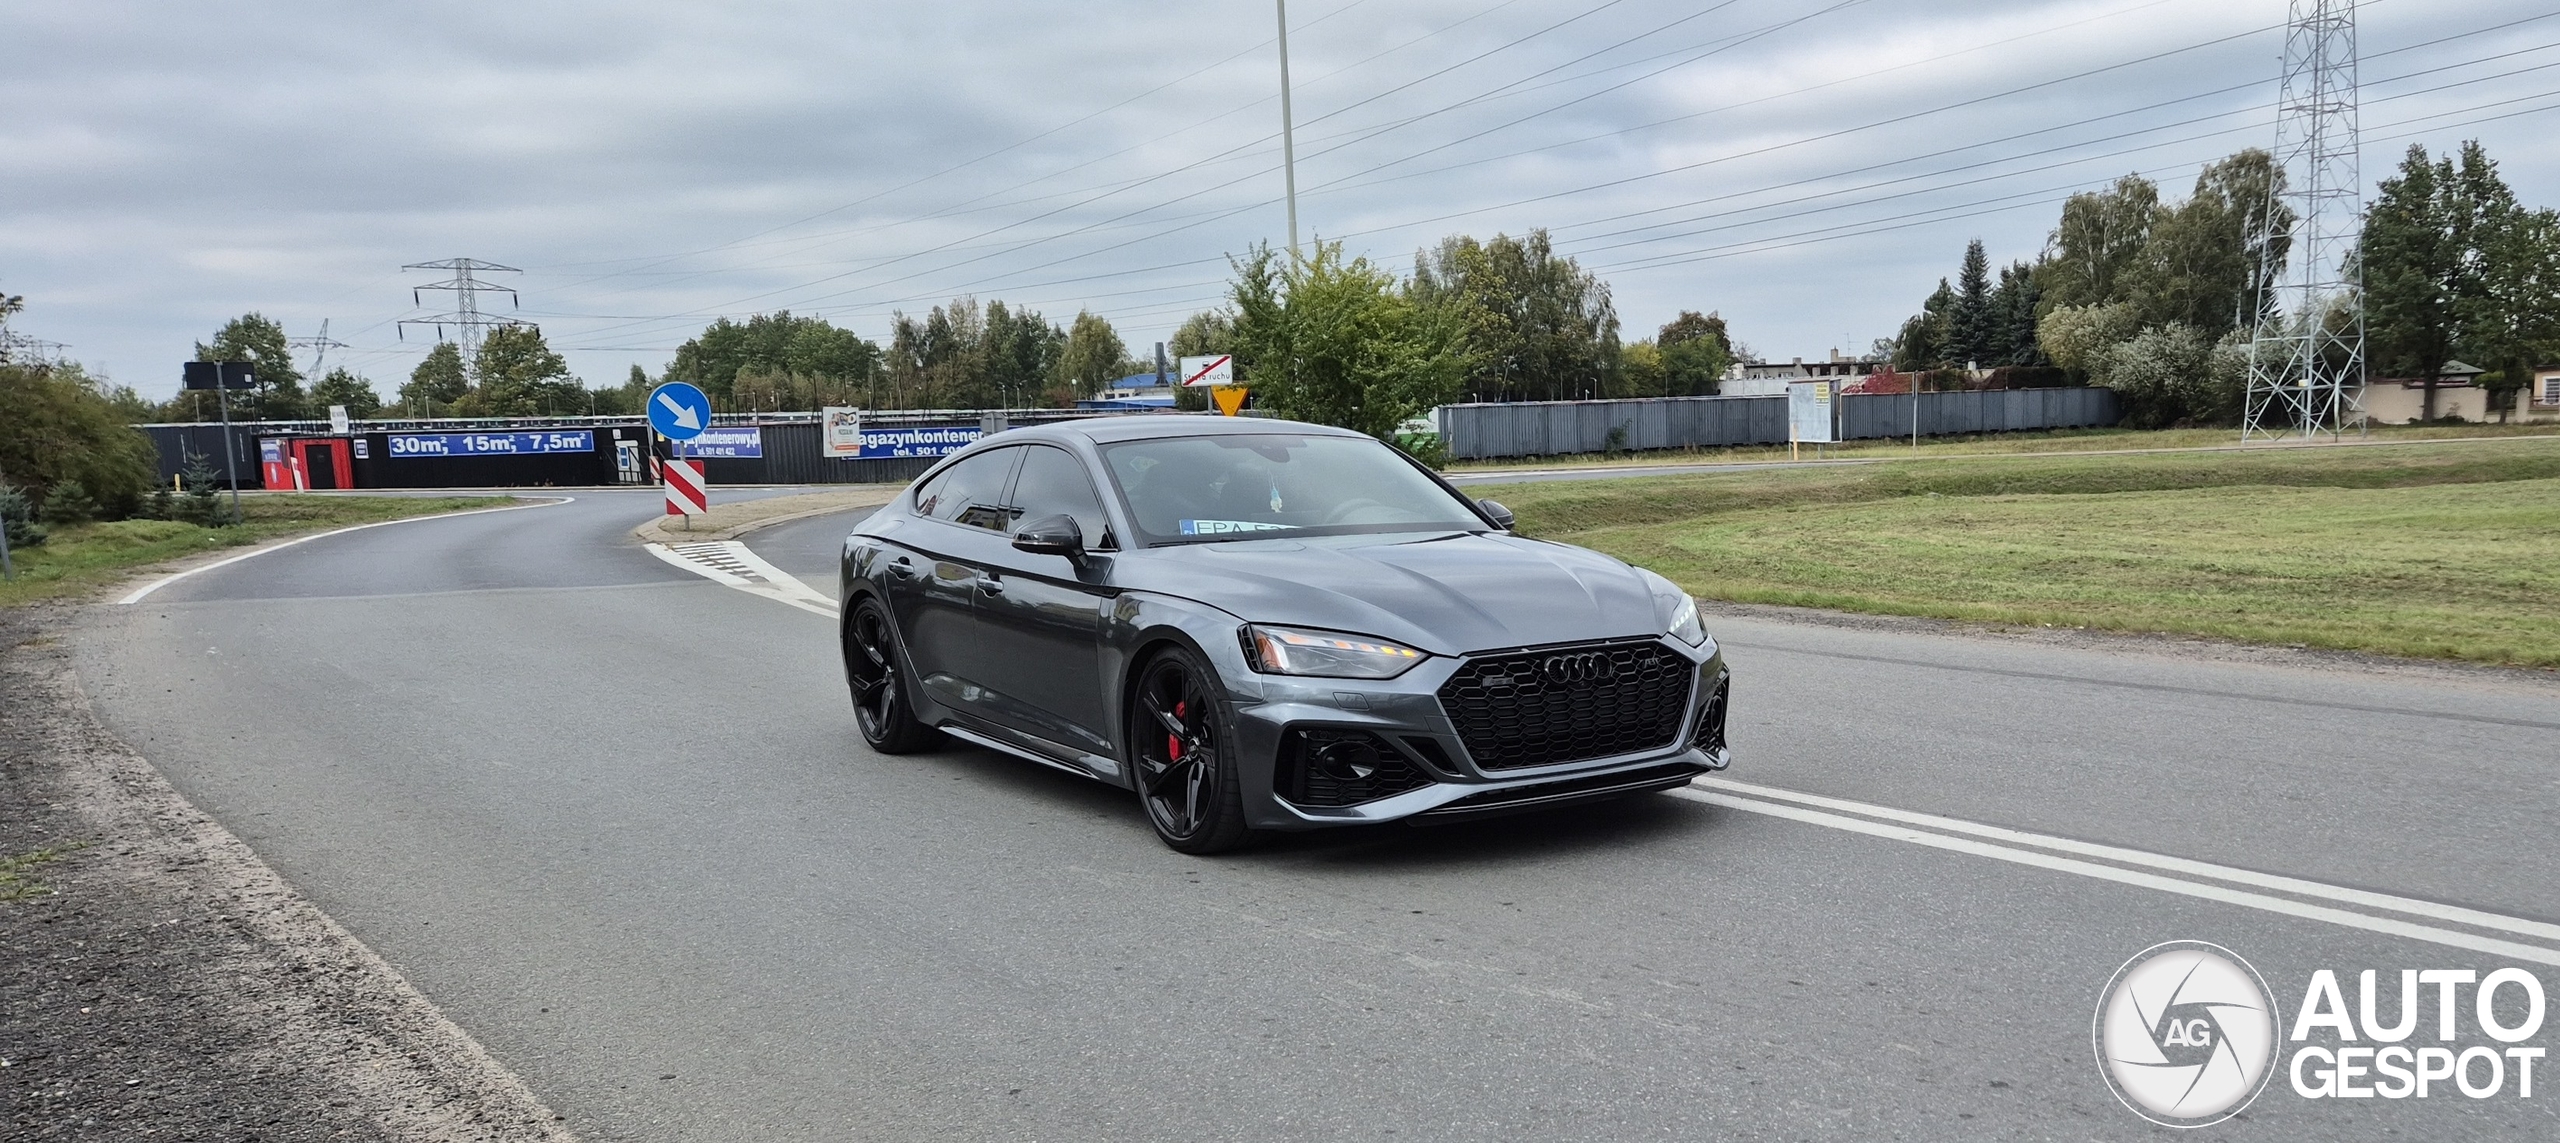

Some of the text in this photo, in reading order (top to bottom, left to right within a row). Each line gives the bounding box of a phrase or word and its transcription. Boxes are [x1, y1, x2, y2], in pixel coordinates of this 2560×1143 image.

[1184, 372, 1230, 381] Sta ruchu
[860, 429, 984, 448] agazynkontener
[892, 448, 913, 456] tel.
[916, 446, 937, 455] 501
[1197, 522, 1242, 534] EPA
